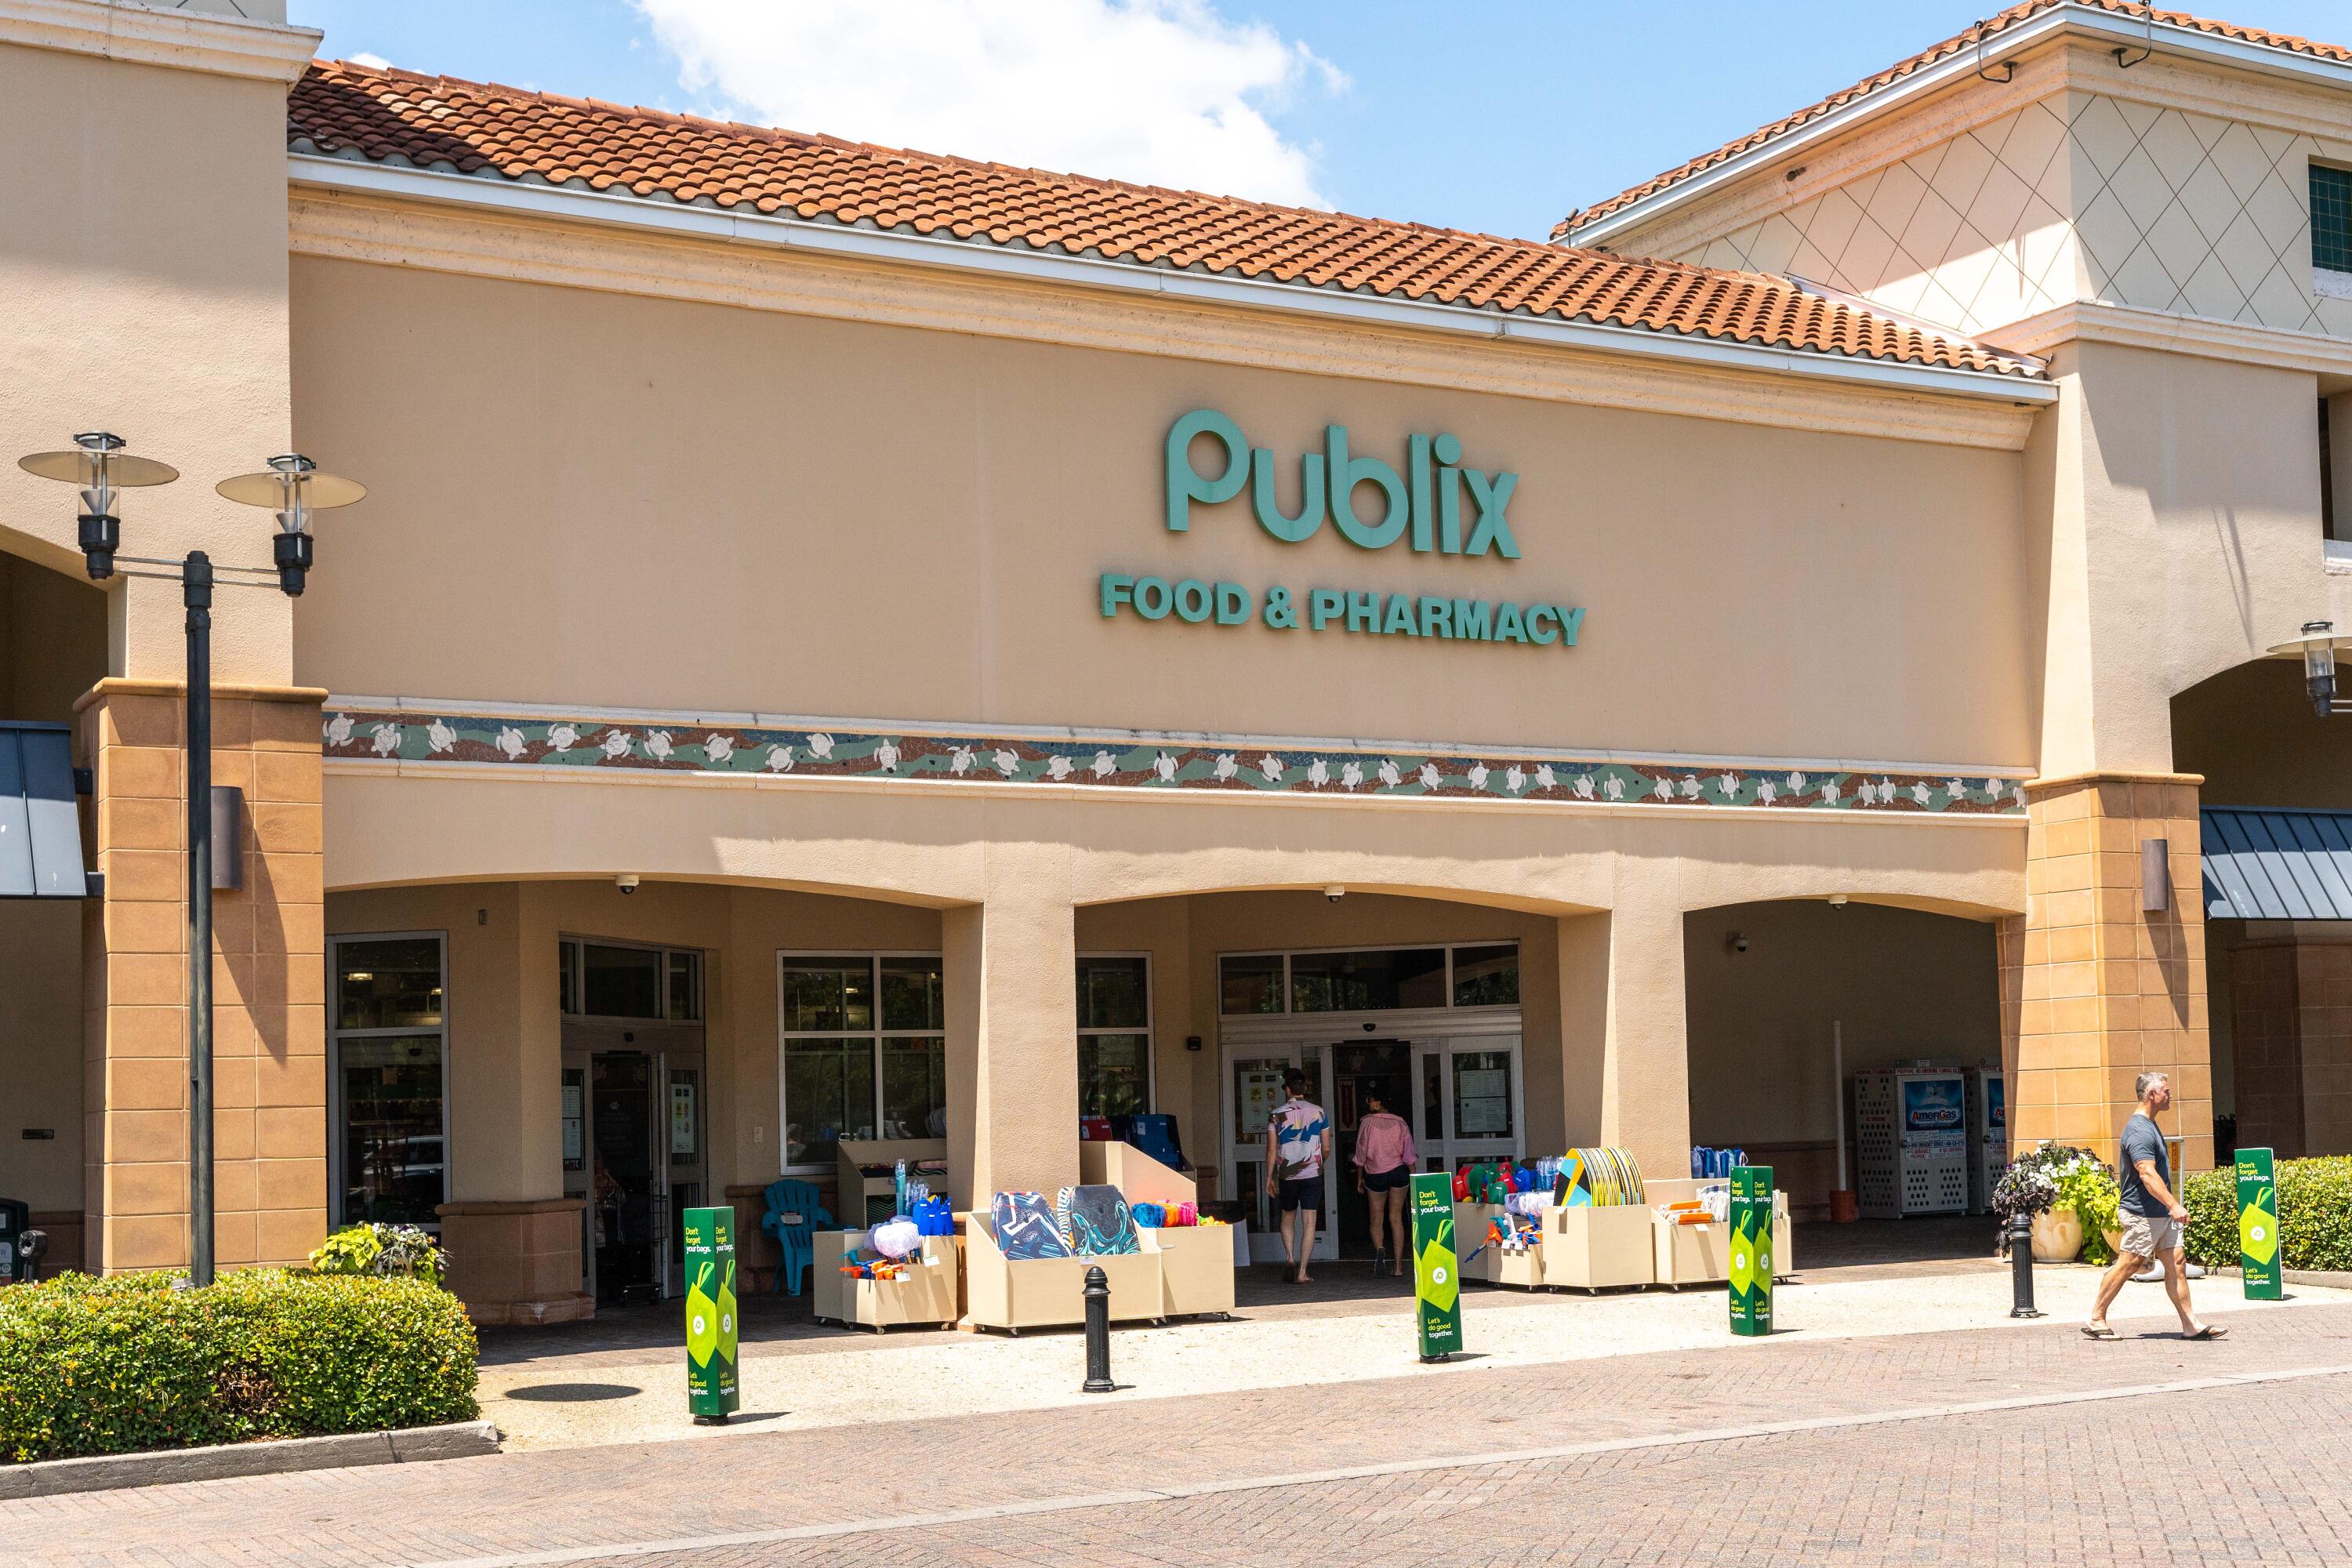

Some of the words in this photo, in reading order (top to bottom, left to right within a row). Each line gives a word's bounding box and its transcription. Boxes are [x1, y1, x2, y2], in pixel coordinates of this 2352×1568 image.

[1165, 408, 1523, 559] Publix
[1099, 573, 1252, 626] FOOD
[1262, 585, 1300, 630] &
[1309, 589, 1588, 647] PHARMACY
[1911, 1109, 1957, 1123] AmeriGas
[1419, 1190, 1436, 1199] Don't
[1421, 1207, 1434, 1215] your
[715, 1226, 726, 1235] Don't
[685, 1236, 701, 1246] forget
[716, 1236, 728, 1245] forget
[686, 1246, 697, 1254] your
[697, 1244, 712, 1254] bags.
[716, 1245, 724, 1254] your
[1436, 1322, 1451, 1331] good
[1428, 1330, 1454, 1339] together.
